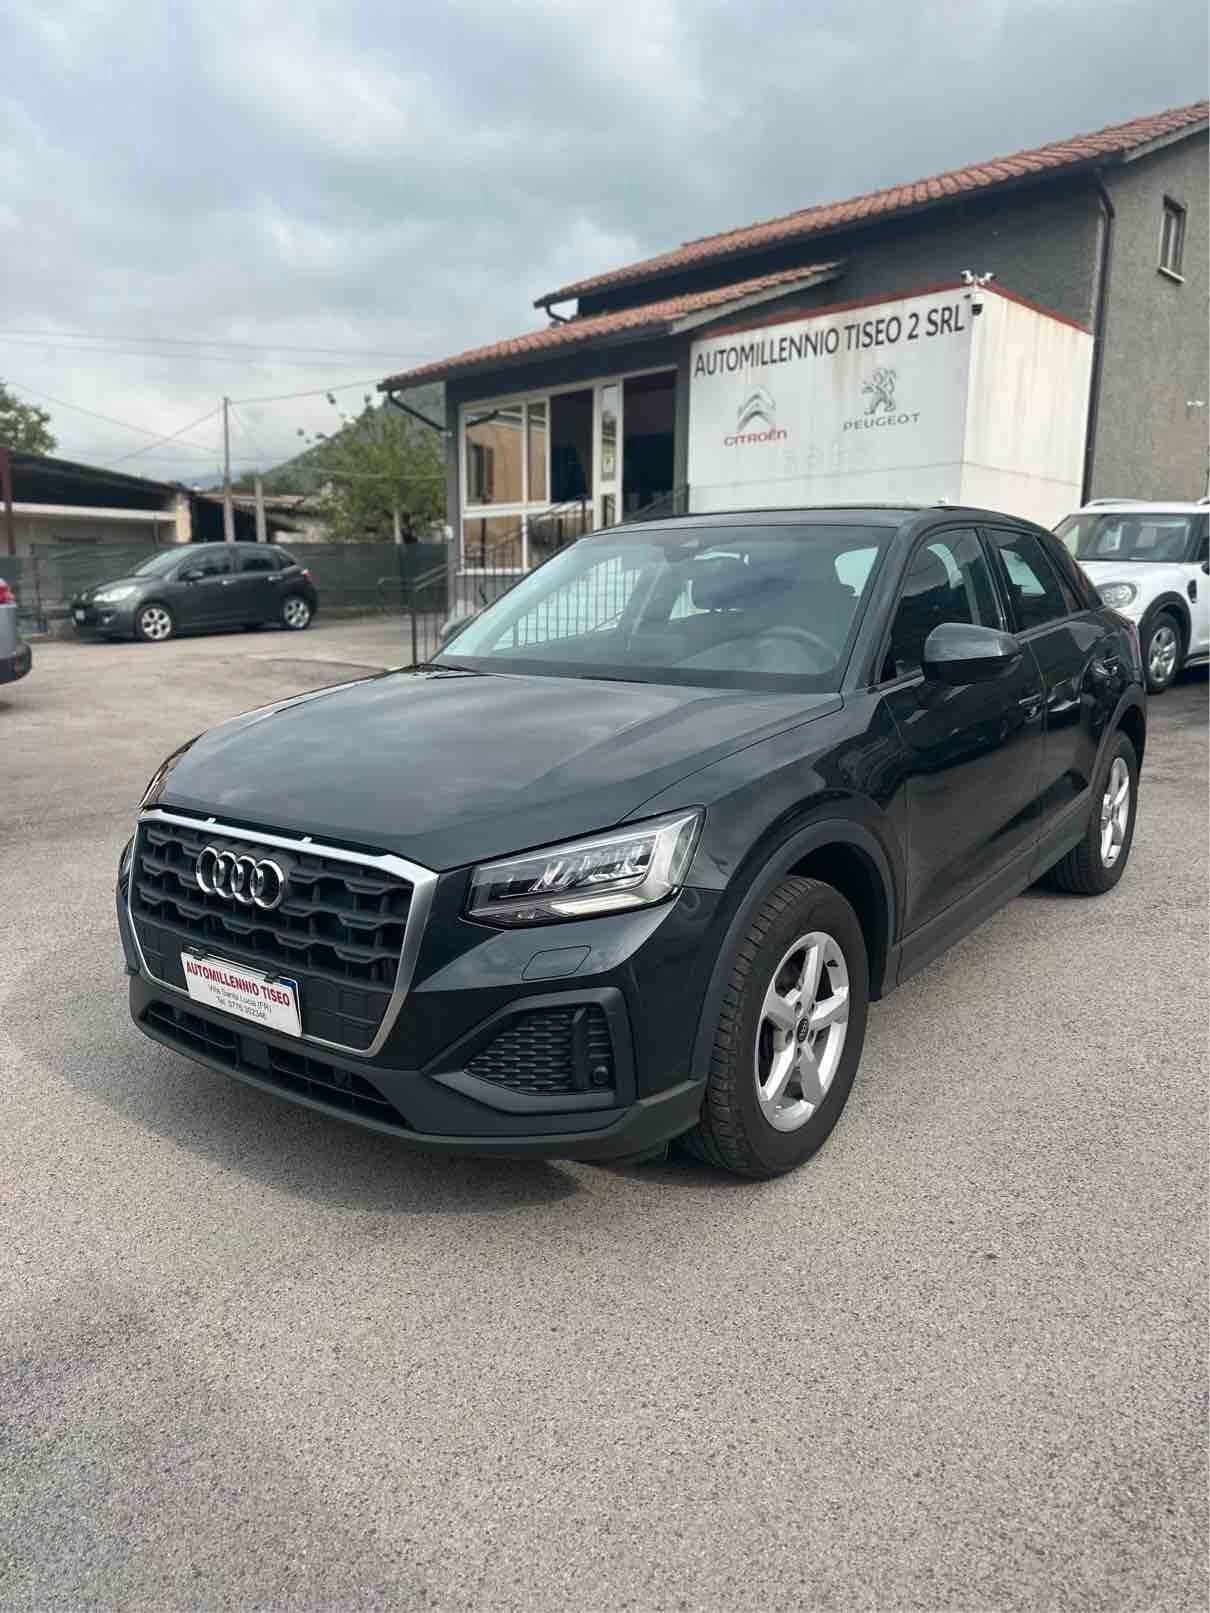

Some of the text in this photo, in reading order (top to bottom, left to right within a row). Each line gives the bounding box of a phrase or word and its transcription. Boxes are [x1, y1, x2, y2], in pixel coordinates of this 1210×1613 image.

[694, 304, 965, 377] AUTOMILLENNIO TISEO 2 SRL
[843, 412, 920, 431] PEUGEOT
[186, 961, 290, 1006] AUTOMILLENNIO TISEO
